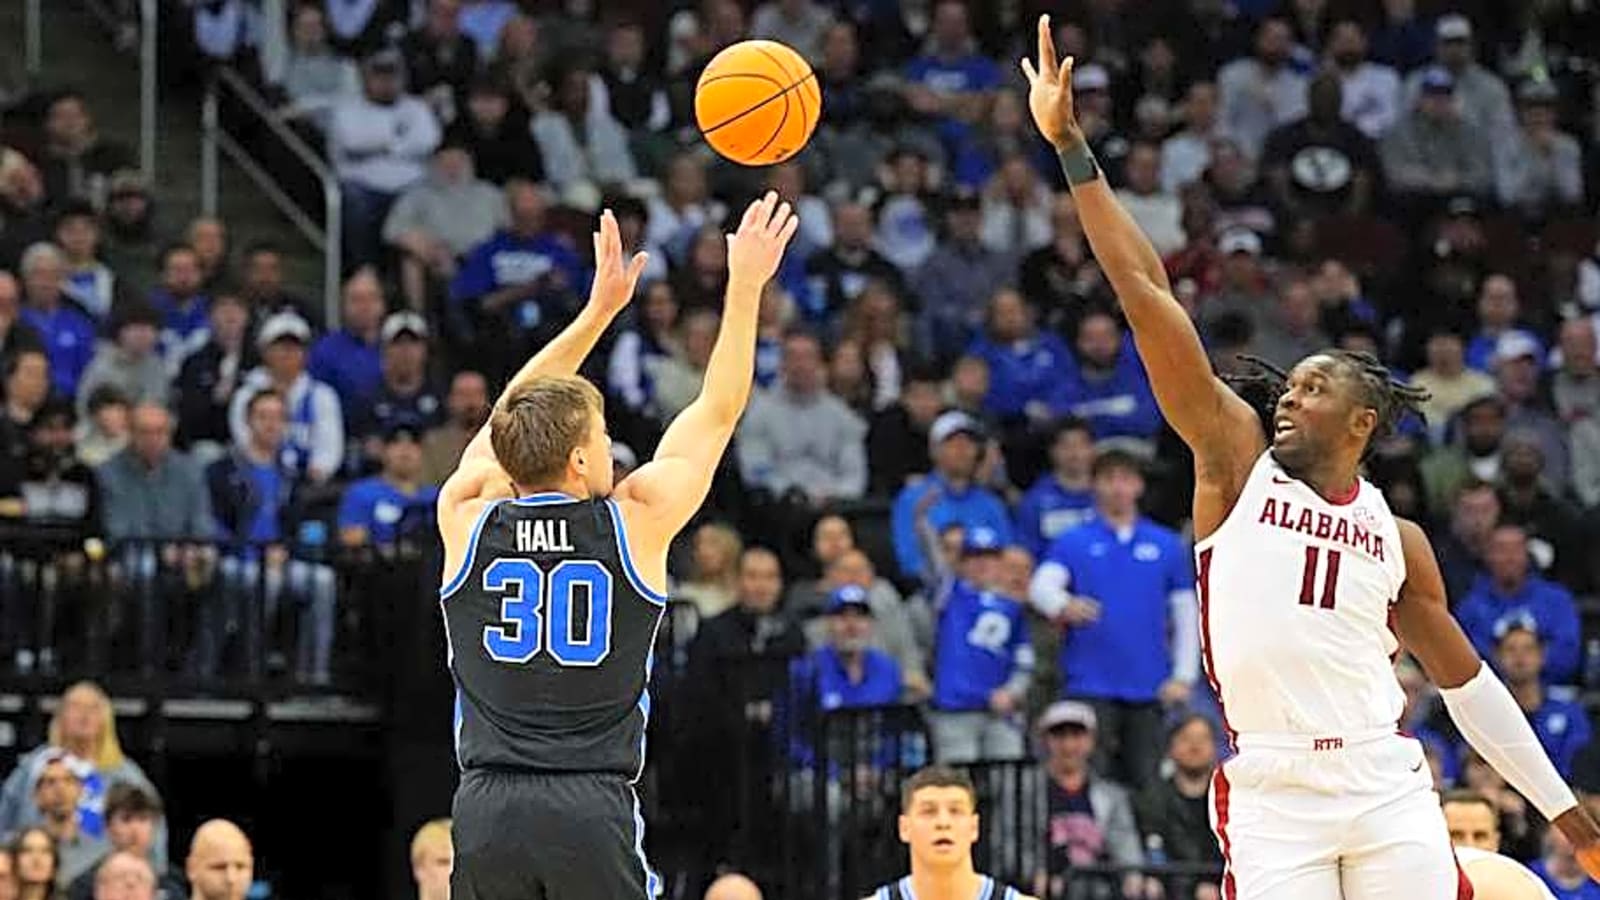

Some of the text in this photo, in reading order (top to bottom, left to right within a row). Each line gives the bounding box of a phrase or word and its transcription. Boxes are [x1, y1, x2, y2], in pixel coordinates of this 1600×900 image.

[516, 519, 575, 552] HALL
[1259, 497, 1385, 562] ALABAMA
[1298, 545, 1341, 610] 11
[483, 558, 613, 666] 30
